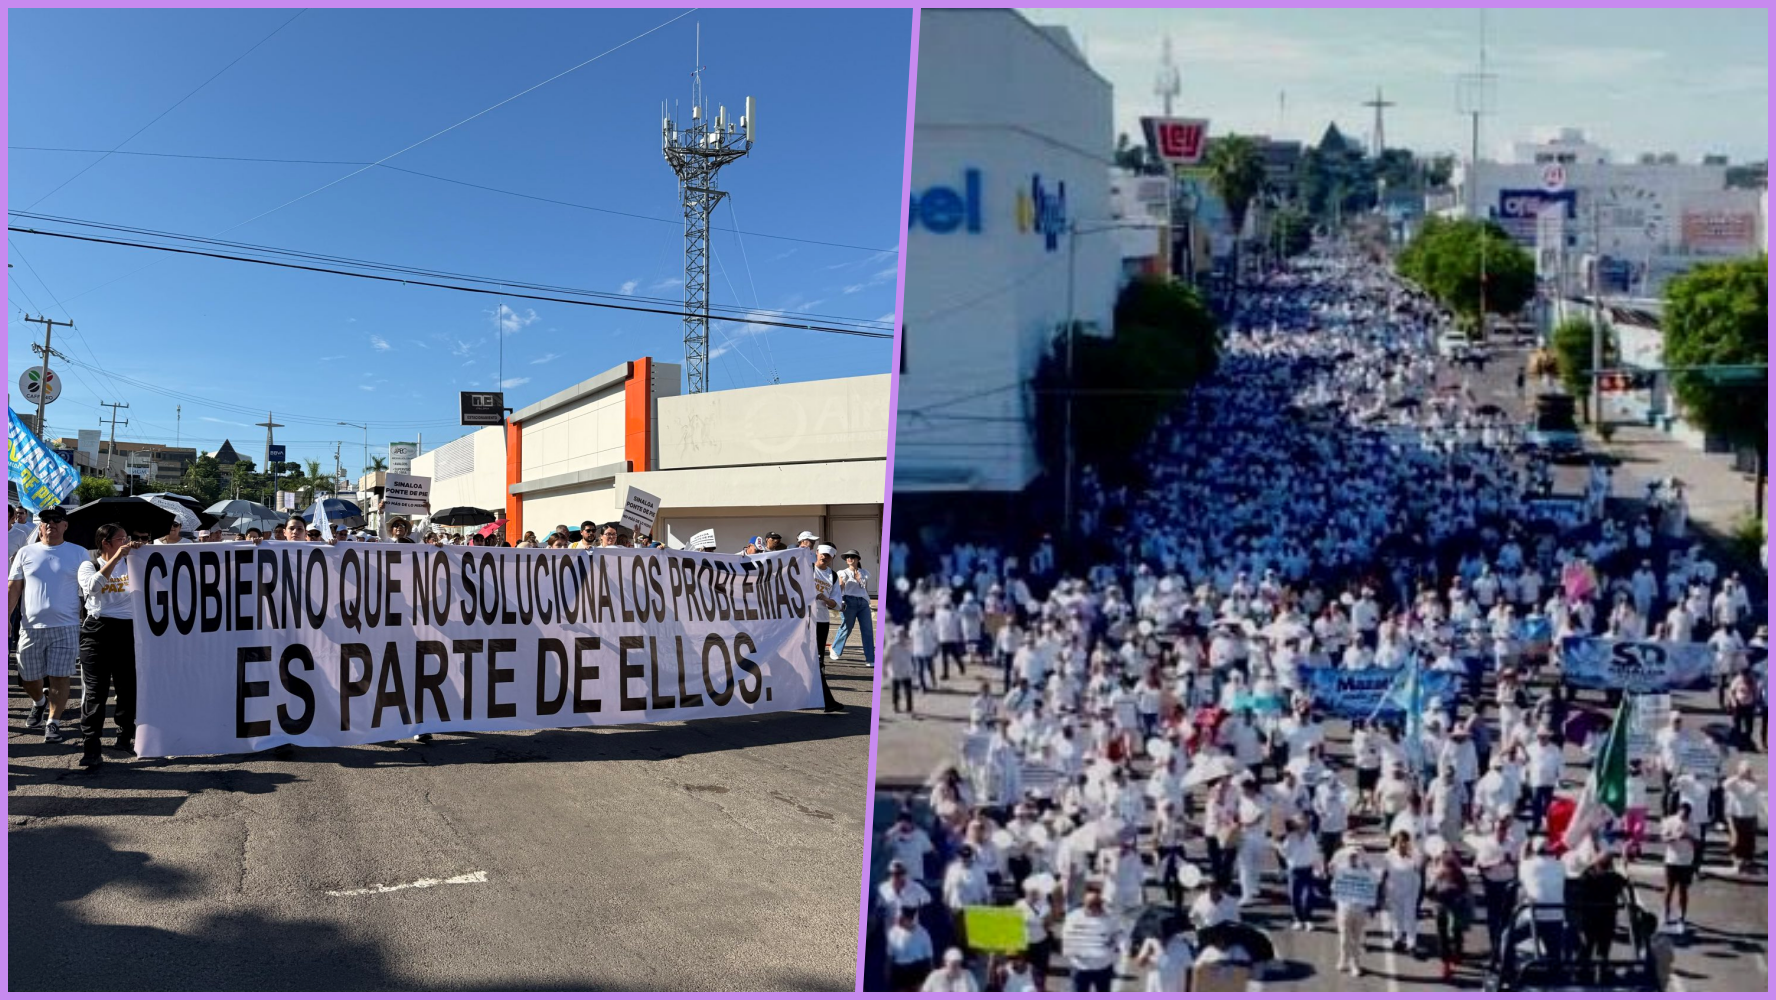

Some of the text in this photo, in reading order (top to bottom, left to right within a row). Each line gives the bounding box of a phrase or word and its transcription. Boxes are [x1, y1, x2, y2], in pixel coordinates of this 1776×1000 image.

[626, 501, 643, 512] PONTE
[633, 496, 653, 508] SINALOA
[101, 582, 126, 595] PAZ
[144, 548, 813, 637] GOBIERNO QUE NO SOLUCIONA LOS PROBLEMAS,
[235, 631, 773, 739] ES PARTE DE ELLOS.
